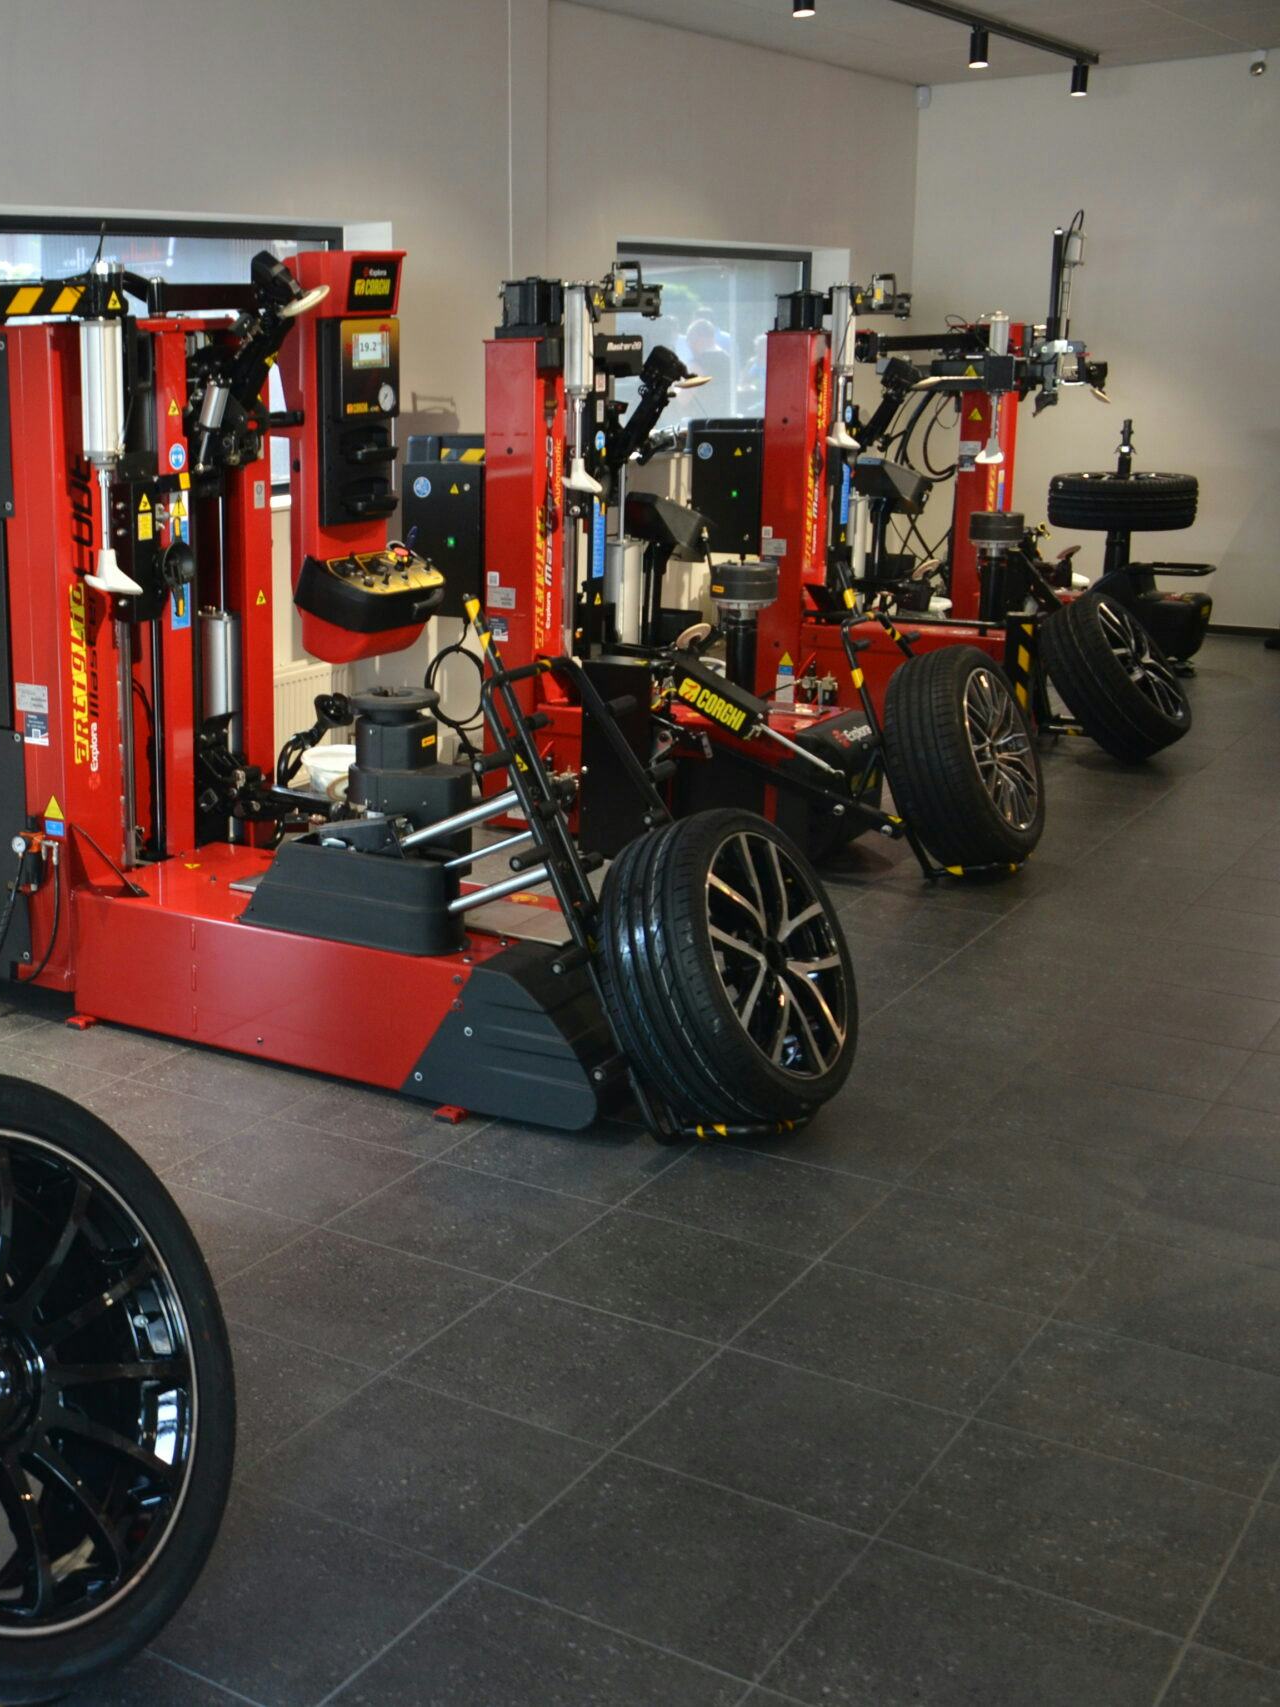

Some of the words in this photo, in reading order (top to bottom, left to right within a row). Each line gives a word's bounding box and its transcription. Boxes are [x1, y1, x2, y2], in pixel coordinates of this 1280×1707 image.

[365, 278, 391, 296] CORGHI
[553, 438, 562, 506] Automatic
[696, 688, 747, 732] CORGHI
[90, 722, 100, 773] Explora
